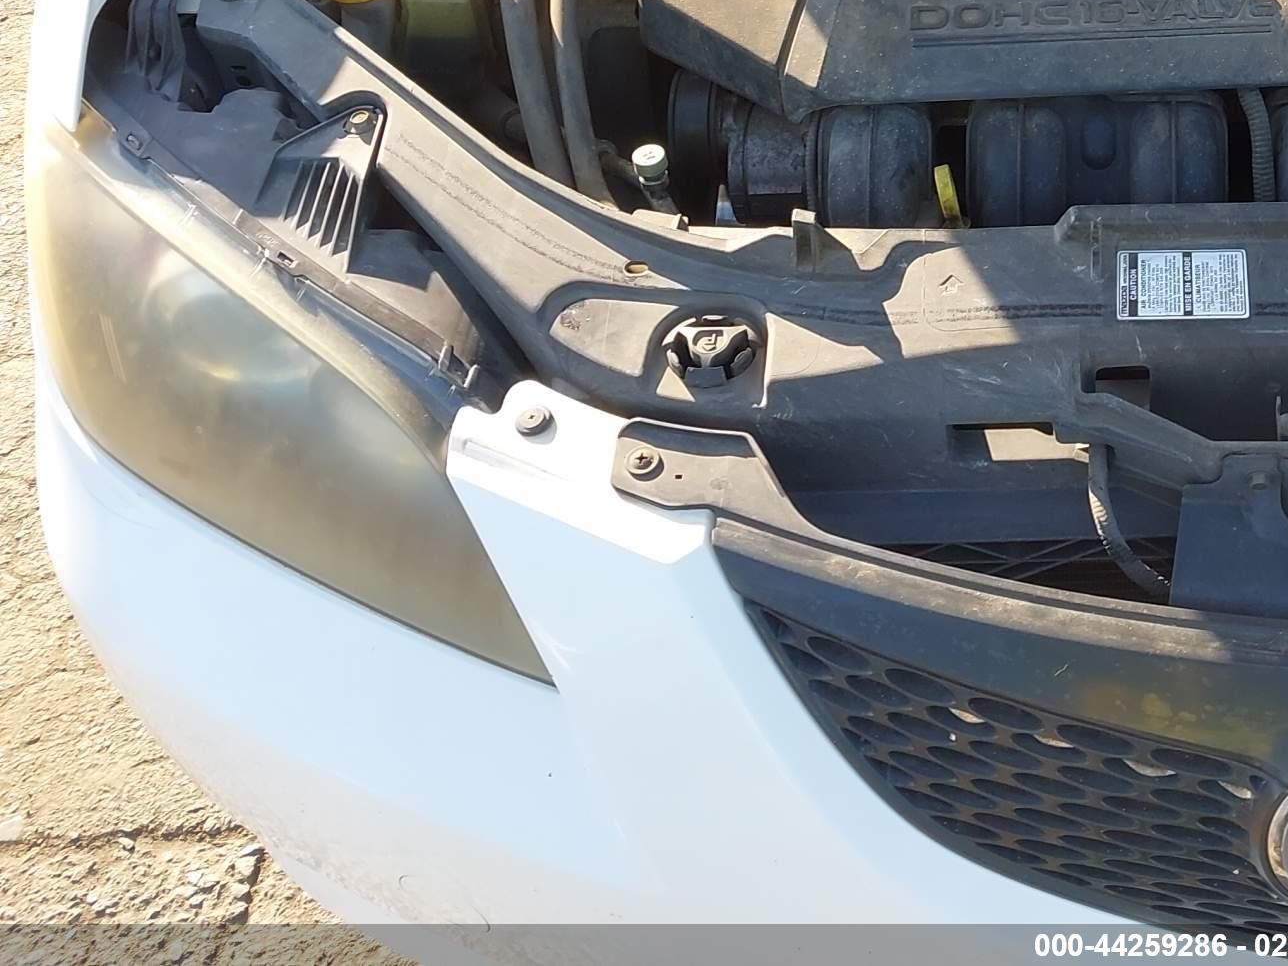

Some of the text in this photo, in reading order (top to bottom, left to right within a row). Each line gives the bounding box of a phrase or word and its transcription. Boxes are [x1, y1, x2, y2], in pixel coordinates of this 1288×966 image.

[909, 1, 1070, 31] DOHC
[1129, 268, 1137, 301] CAUTION
[1183, 256, 1192, 312] MISE EN GARDE
